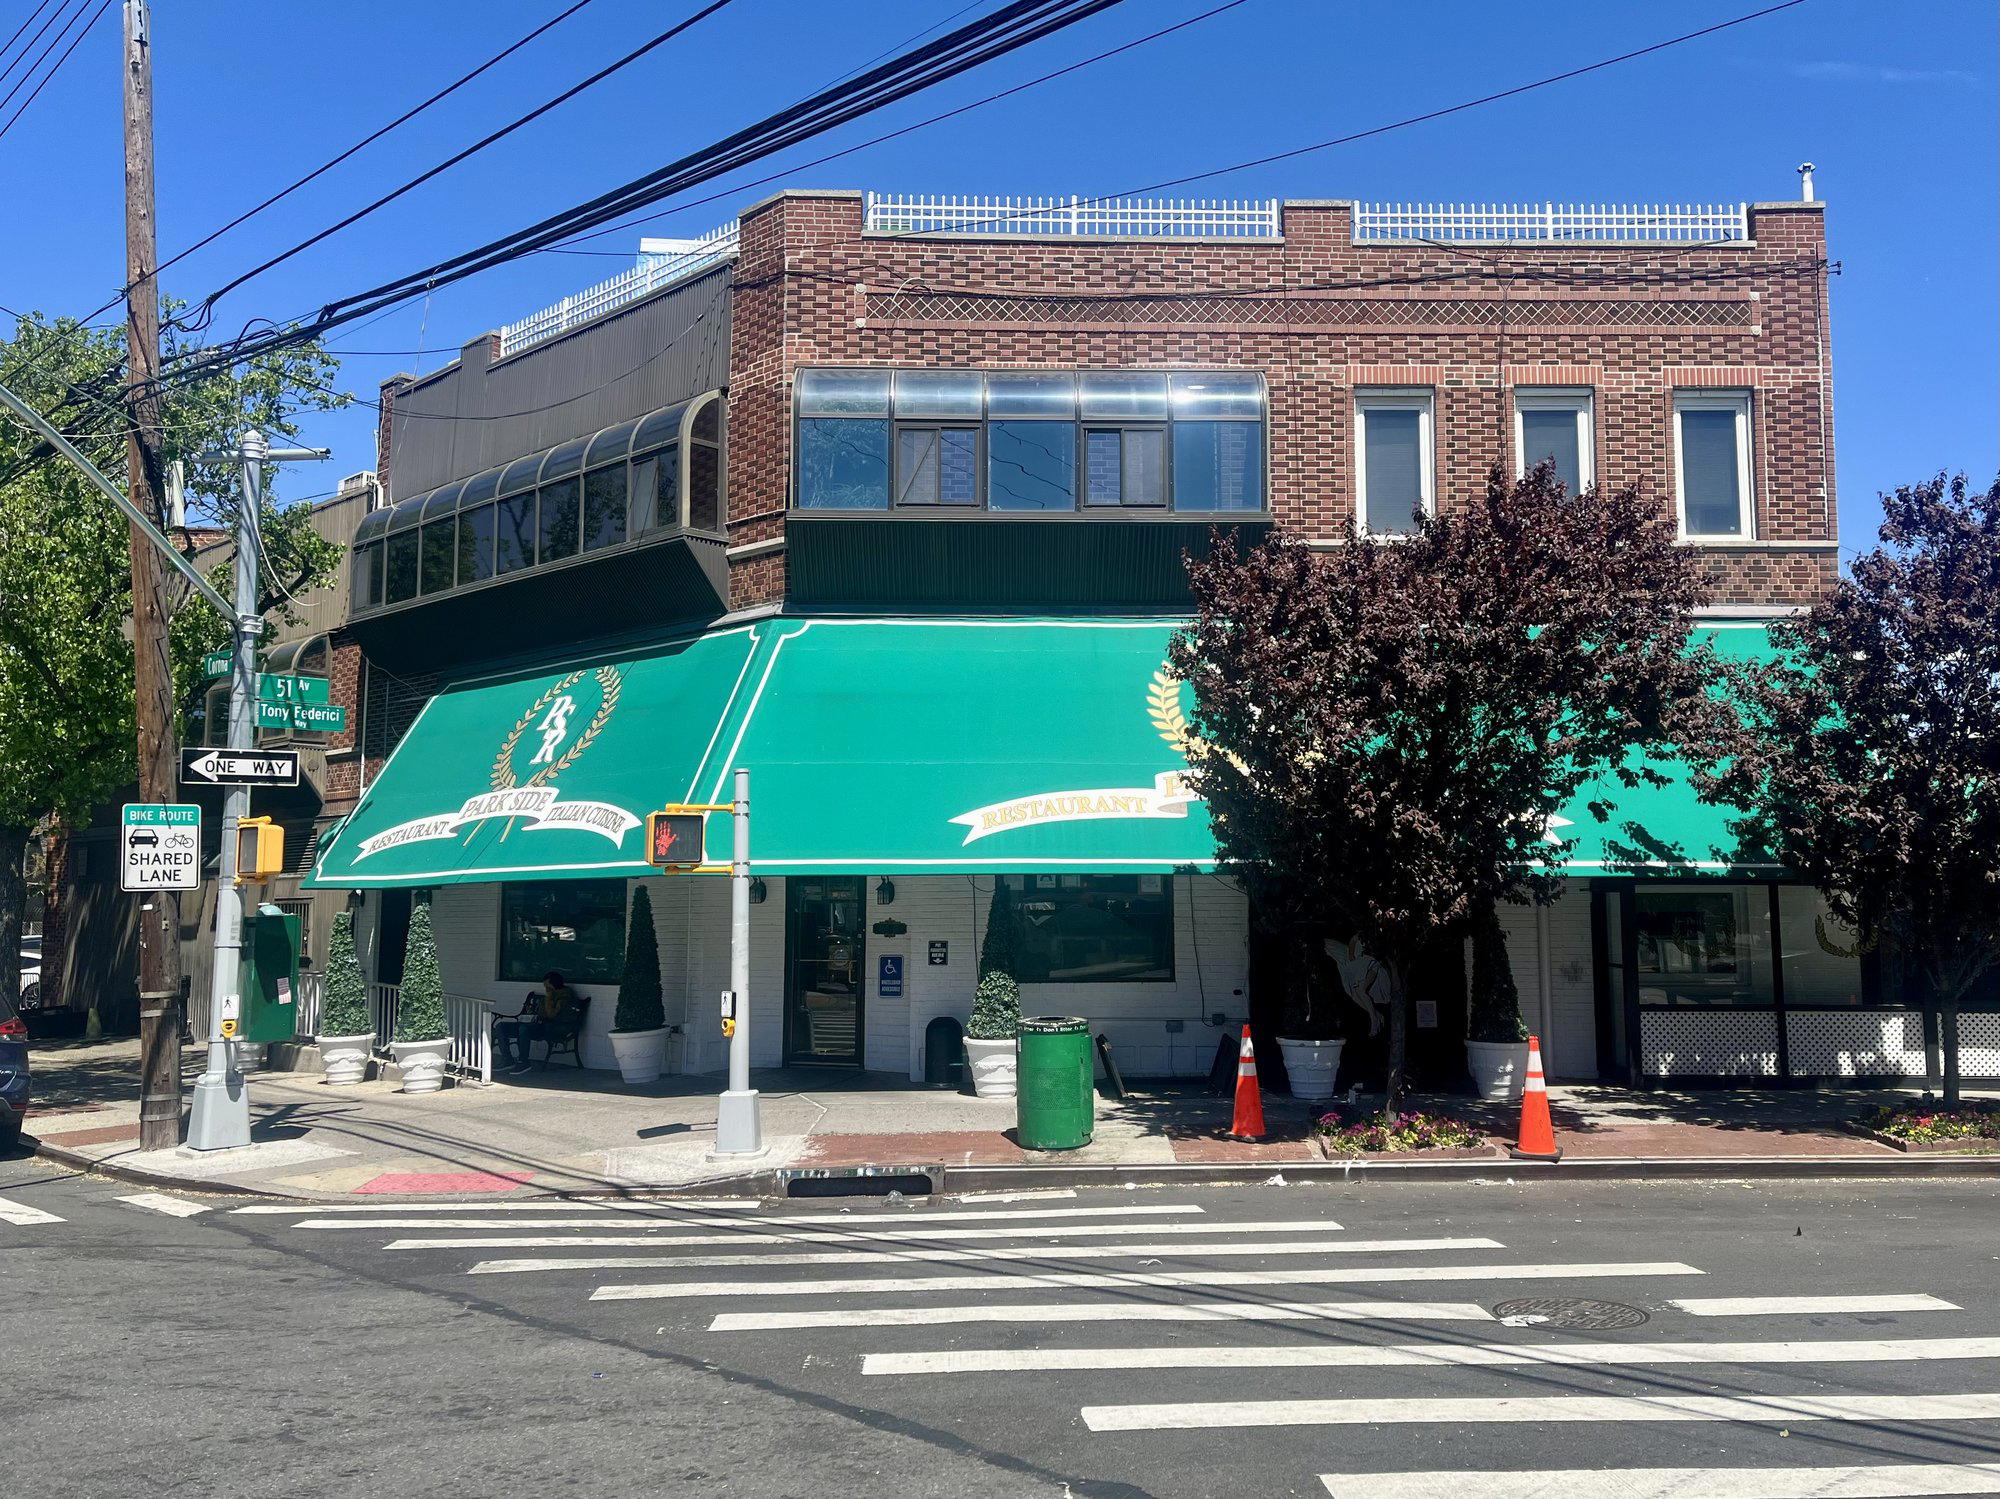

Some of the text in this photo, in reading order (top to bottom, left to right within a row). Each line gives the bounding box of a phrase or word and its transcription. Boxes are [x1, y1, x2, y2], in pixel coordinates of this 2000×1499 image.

[277, 678, 310, 698] 51 Av
[261, 703, 340, 721] Tony Federici
[294, 719, 308, 729] Way
[205, 760, 286, 774] ONE WAY
[459, 791, 552, 820] PARK SIDE
[982, 796, 1147, 830] RESTAURANT
[129, 810, 194, 821] BIKE ROUTE
[544, 804, 627, 834] ITALIAN CUISINE
[367, 821, 450, 853] RESTAURANT
[129, 852, 193, 866] SHARED
[140, 869, 182, 882] LANE
